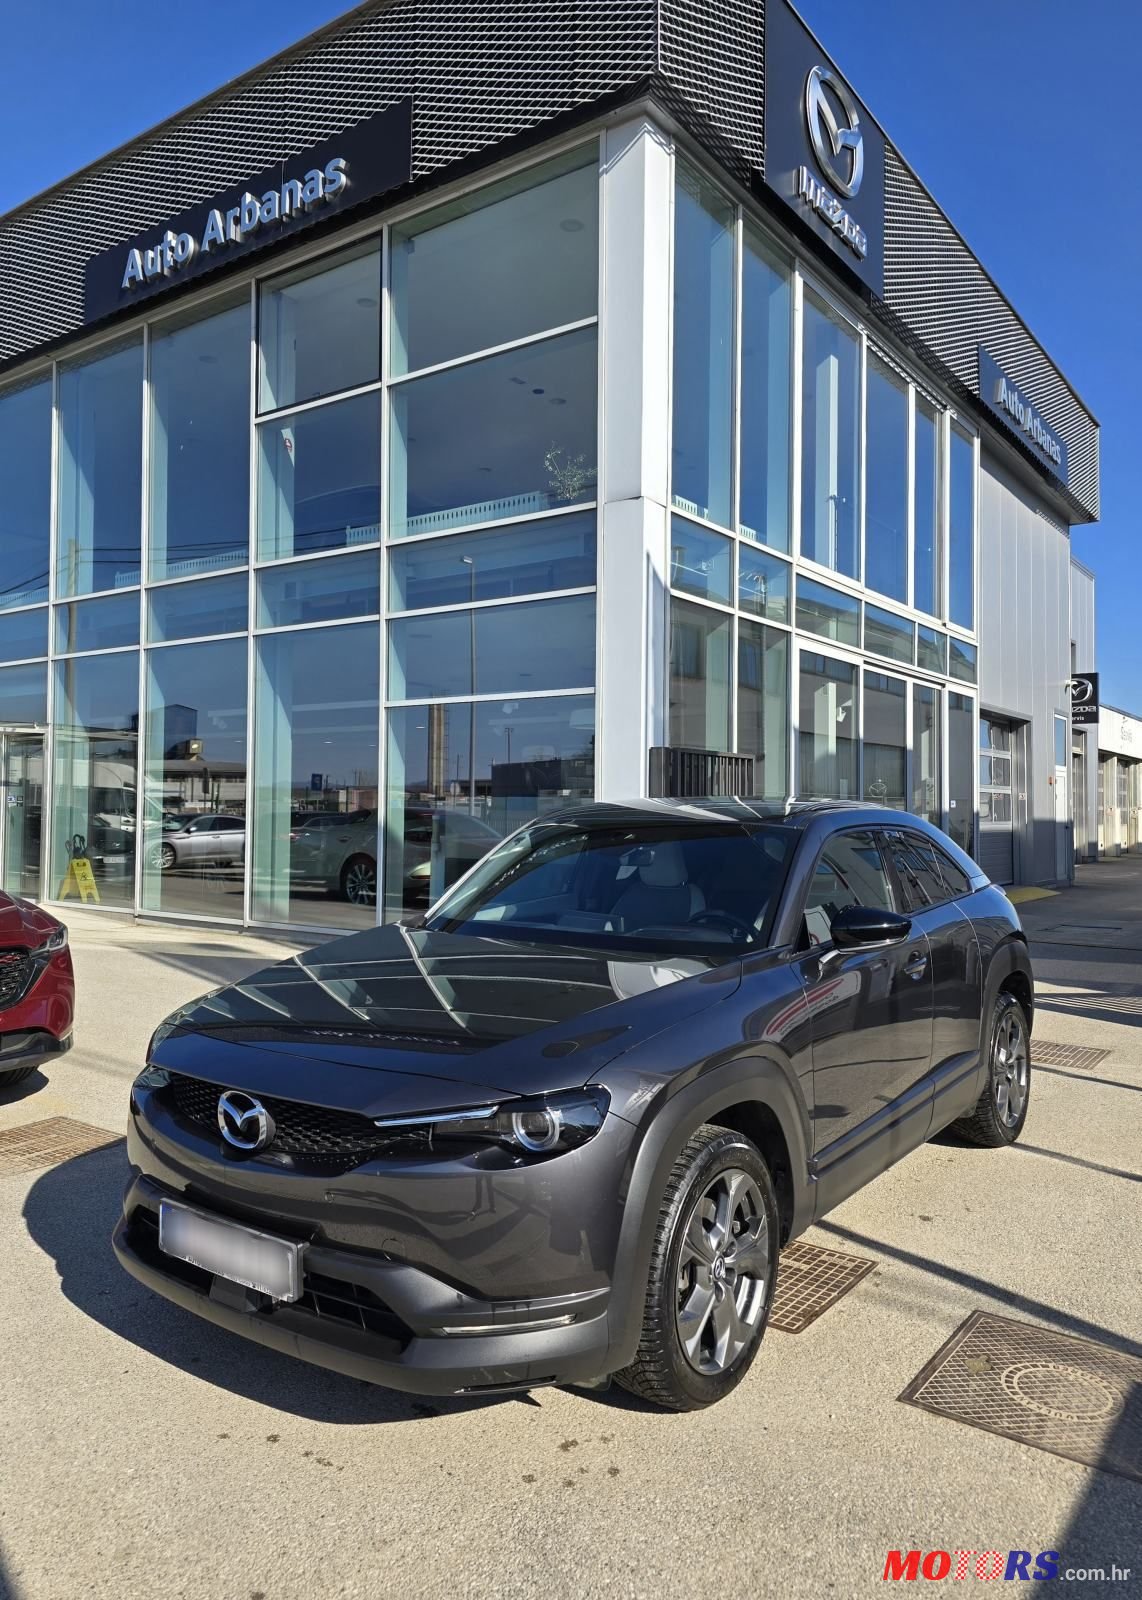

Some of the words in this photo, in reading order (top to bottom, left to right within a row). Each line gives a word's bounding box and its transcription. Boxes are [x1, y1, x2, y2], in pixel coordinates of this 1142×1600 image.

[122, 230, 194, 288] Auto
[201, 158, 347, 251] Arbanas
[997, 378, 1025, 424] Auto
[1024, 407, 1061, 464] Arbanas
